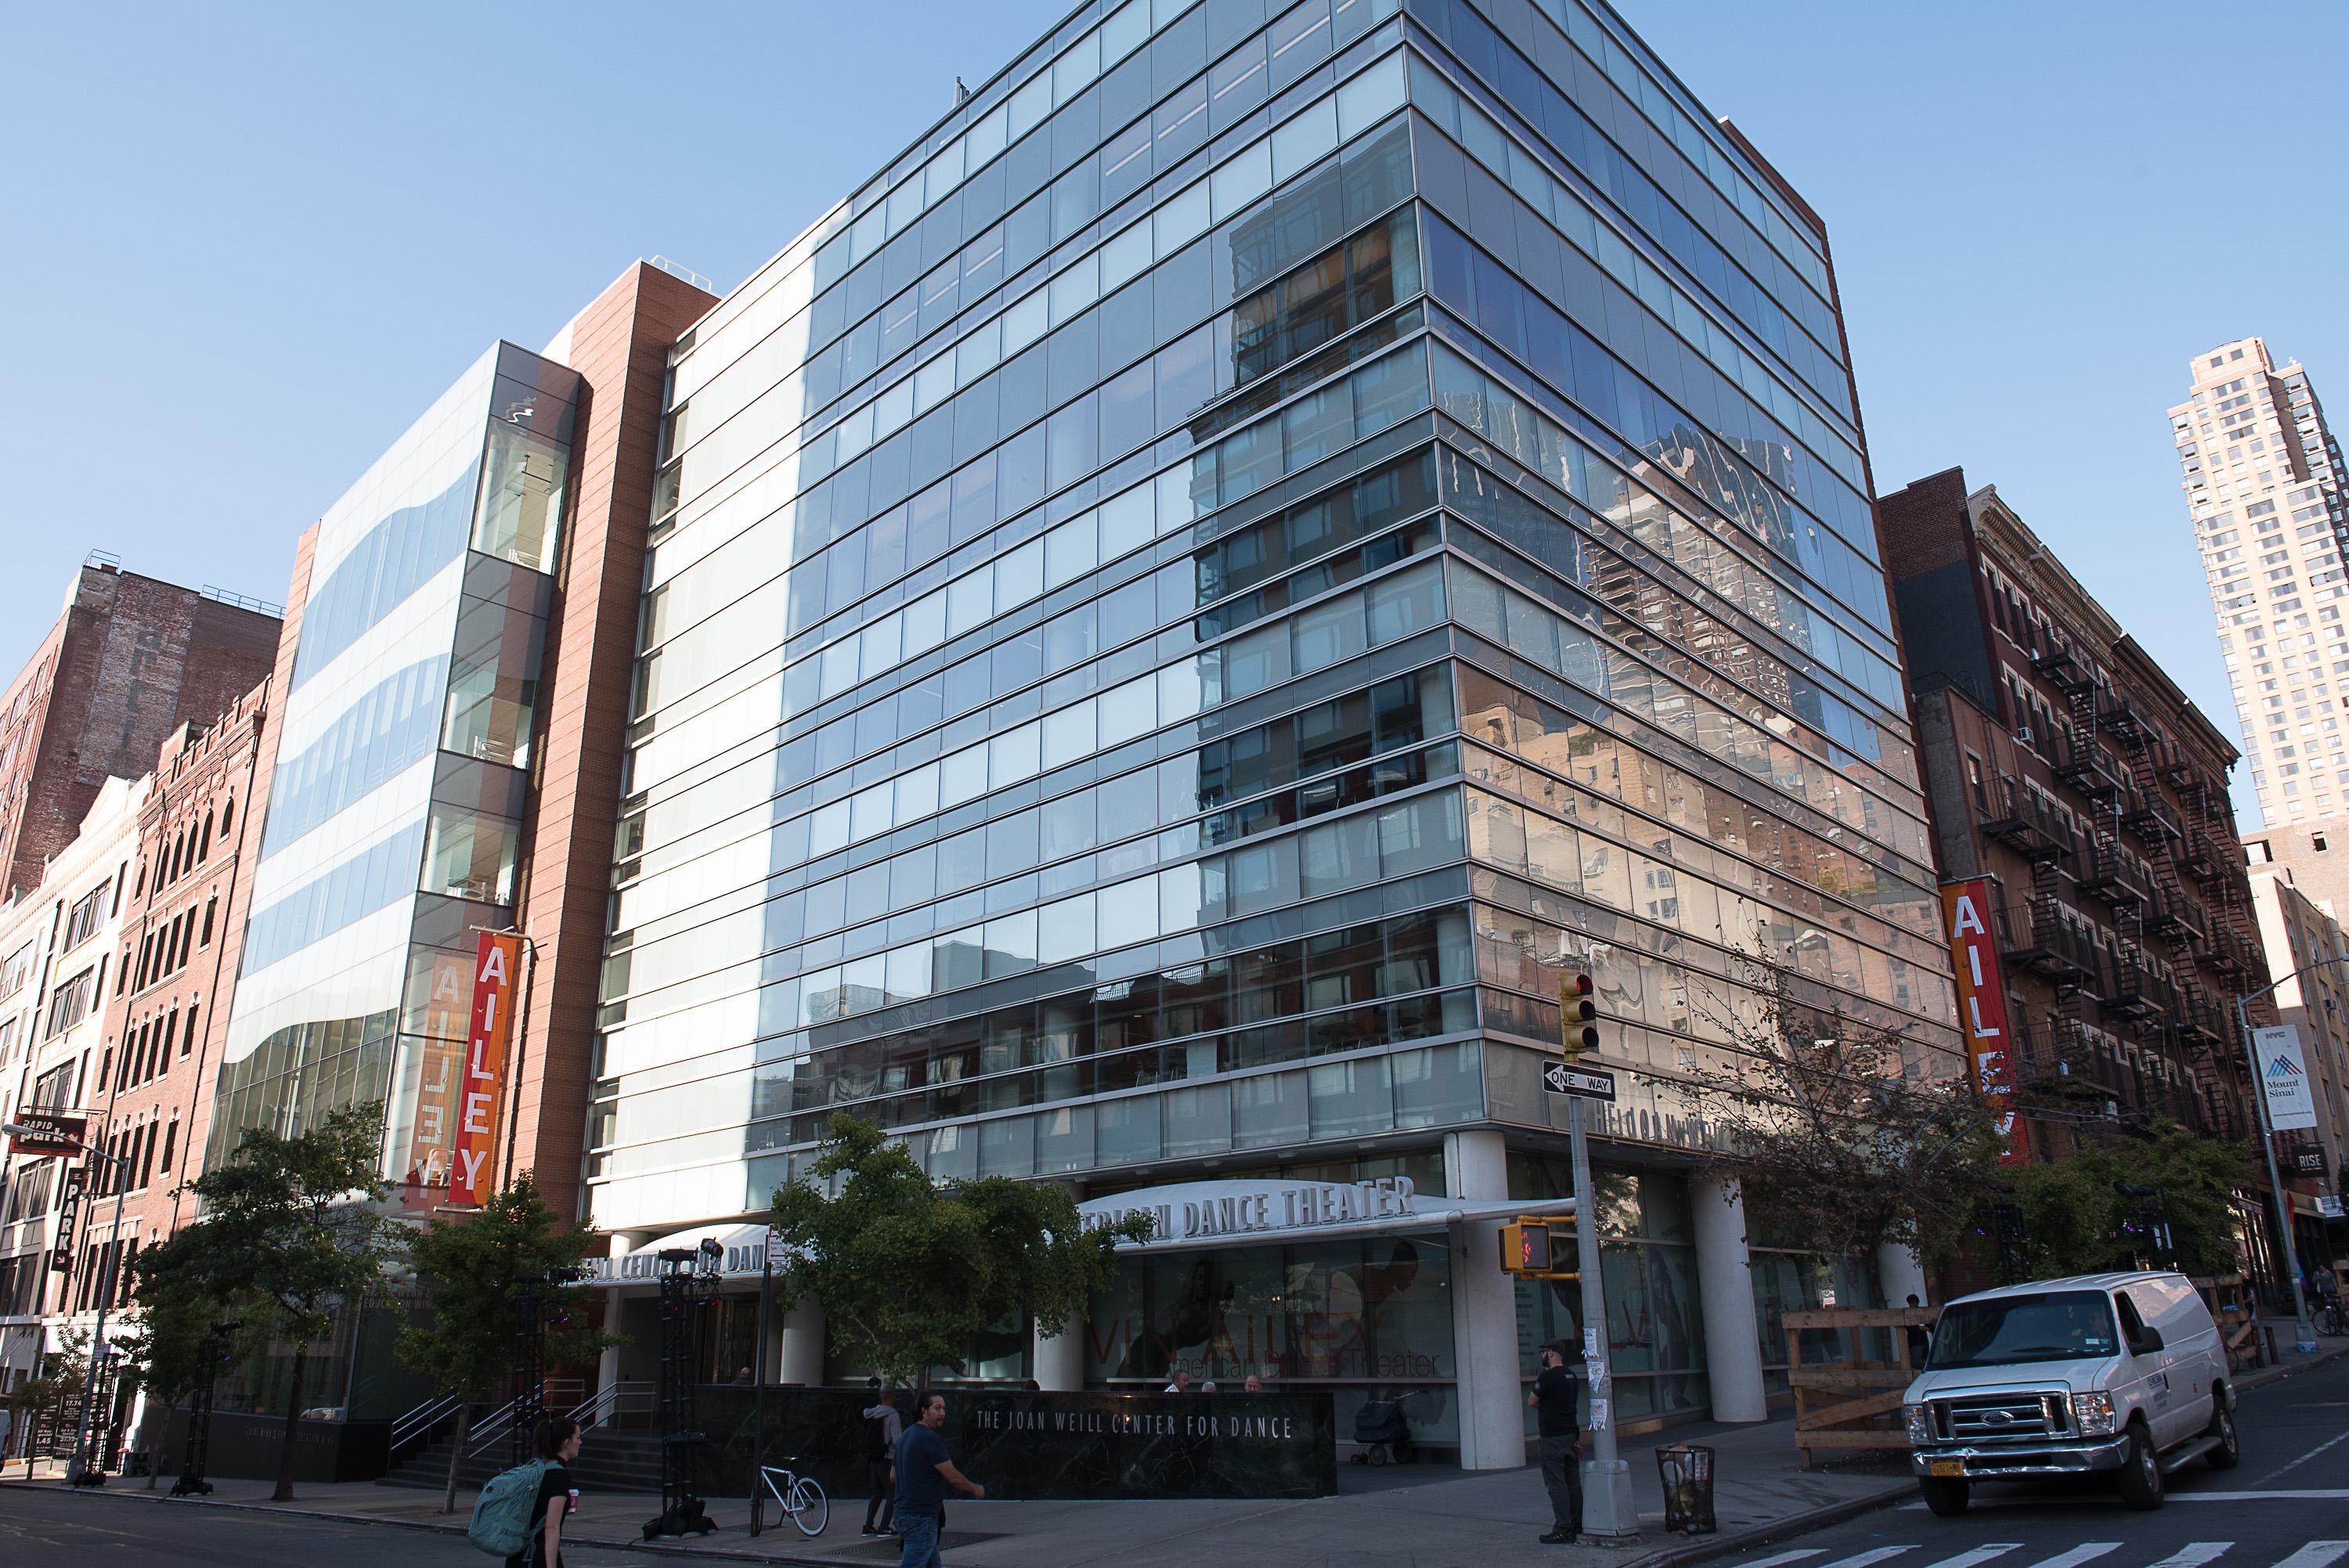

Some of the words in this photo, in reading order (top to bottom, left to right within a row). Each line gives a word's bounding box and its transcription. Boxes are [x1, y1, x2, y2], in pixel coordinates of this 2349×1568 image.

[460, 946, 507, 1190] AILEY
[1551, 1071, 1575, 1086] ONE
[1587, 1076, 1608, 1091] WAY
[2268, 1080, 2299, 1090] Mount
[2269, 1087, 2295, 1098] Sinai
[23, 1119, 53, 1130] RAPID
[2299, 1154, 2322, 1167] RISE
[57, 1184, 78, 1250] PARK
[1183, 1194, 1270, 1236] DANCE
[1281, 1176, 1416, 1229] THEATER
[621, 1254, 683, 1279] CENTE
[728, 1244, 765, 1272] DAN
[363, 1298, 412, 1308] EDUCON
[1087, 1317, 1178, 1364] VIN
[977, 1411, 999, 1429] THE
[1008, 1411, 1045, 1431] JOAN
[1055, 1412, 1102, 1433] WEILL
[1112, 1414, 1174, 1436] CENTER
[1187, 1416, 1218, 1437] FOR
[1232, 1417, 1291, 1439] DANCE
